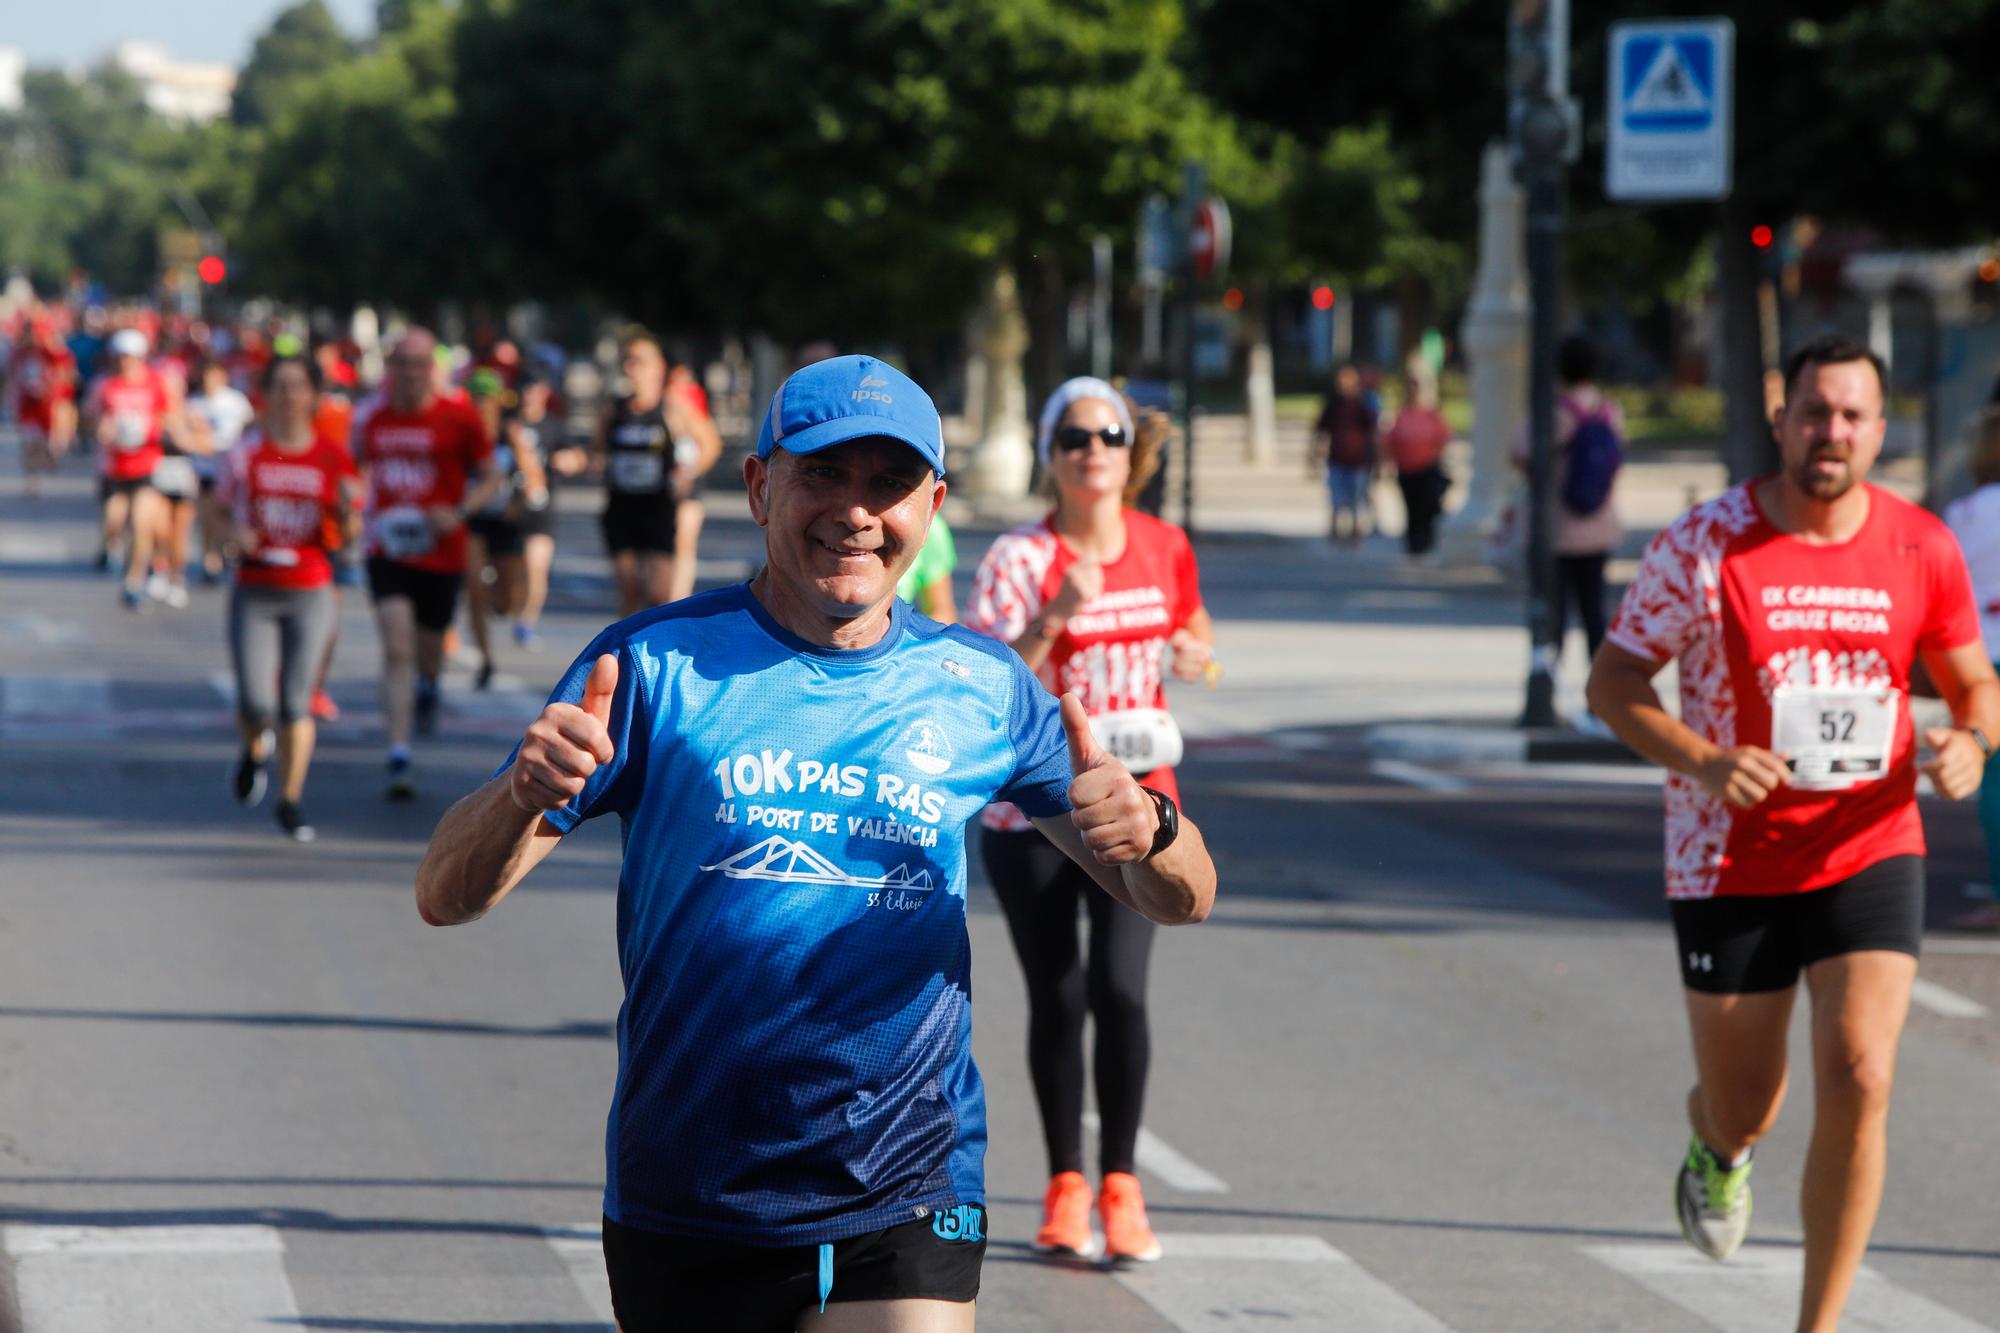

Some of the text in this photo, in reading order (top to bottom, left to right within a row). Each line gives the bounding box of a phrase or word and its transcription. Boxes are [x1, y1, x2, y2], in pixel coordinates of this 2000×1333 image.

[1787, 585, 1893, 611] CARRERA
[1767, 609, 1889, 635] CRUZ ROJA
[1820, 710, 1856, 743] 52
[714, 748, 946, 824] 10K PAS RAS
[715, 803, 938, 848] AL PORT DE VALÈNCIA
[866, 892, 880, 907] 33
